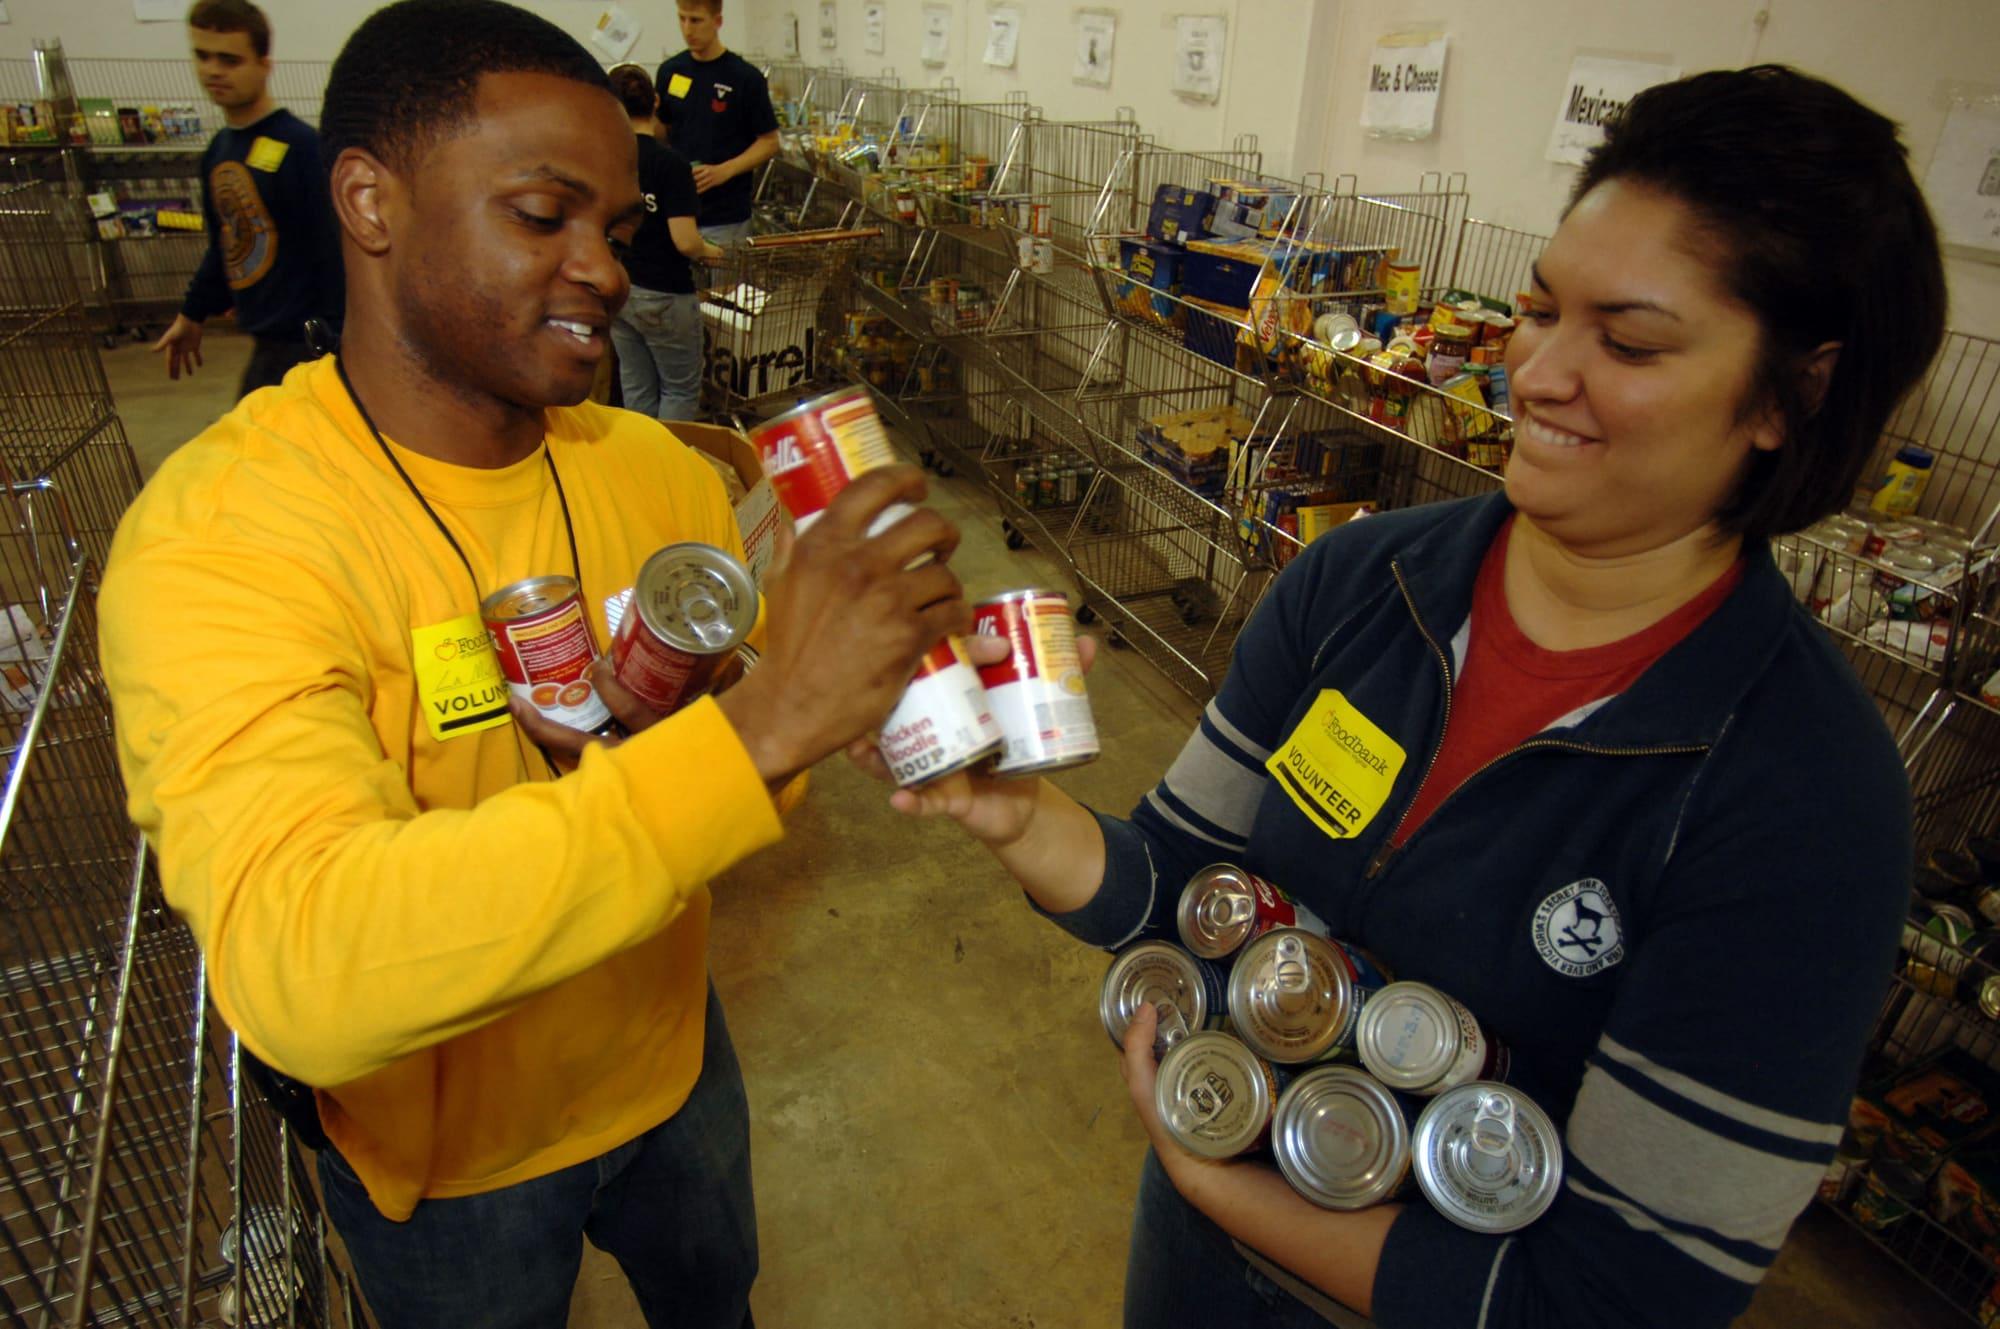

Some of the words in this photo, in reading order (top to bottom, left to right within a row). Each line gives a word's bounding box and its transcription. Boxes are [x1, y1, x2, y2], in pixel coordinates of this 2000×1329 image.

[1370, 64, 1391, 92] Mac
[1404, 64, 1439, 92] Cheese
[434, 682, 509, 716] VOLUN
[894, 747, 945, 780] SOUP
[1328, 717, 1389, 777] Foodbank
[1288, 745, 1362, 825] VOLUNTEER
[1541, 887, 1576, 914] SECRET
